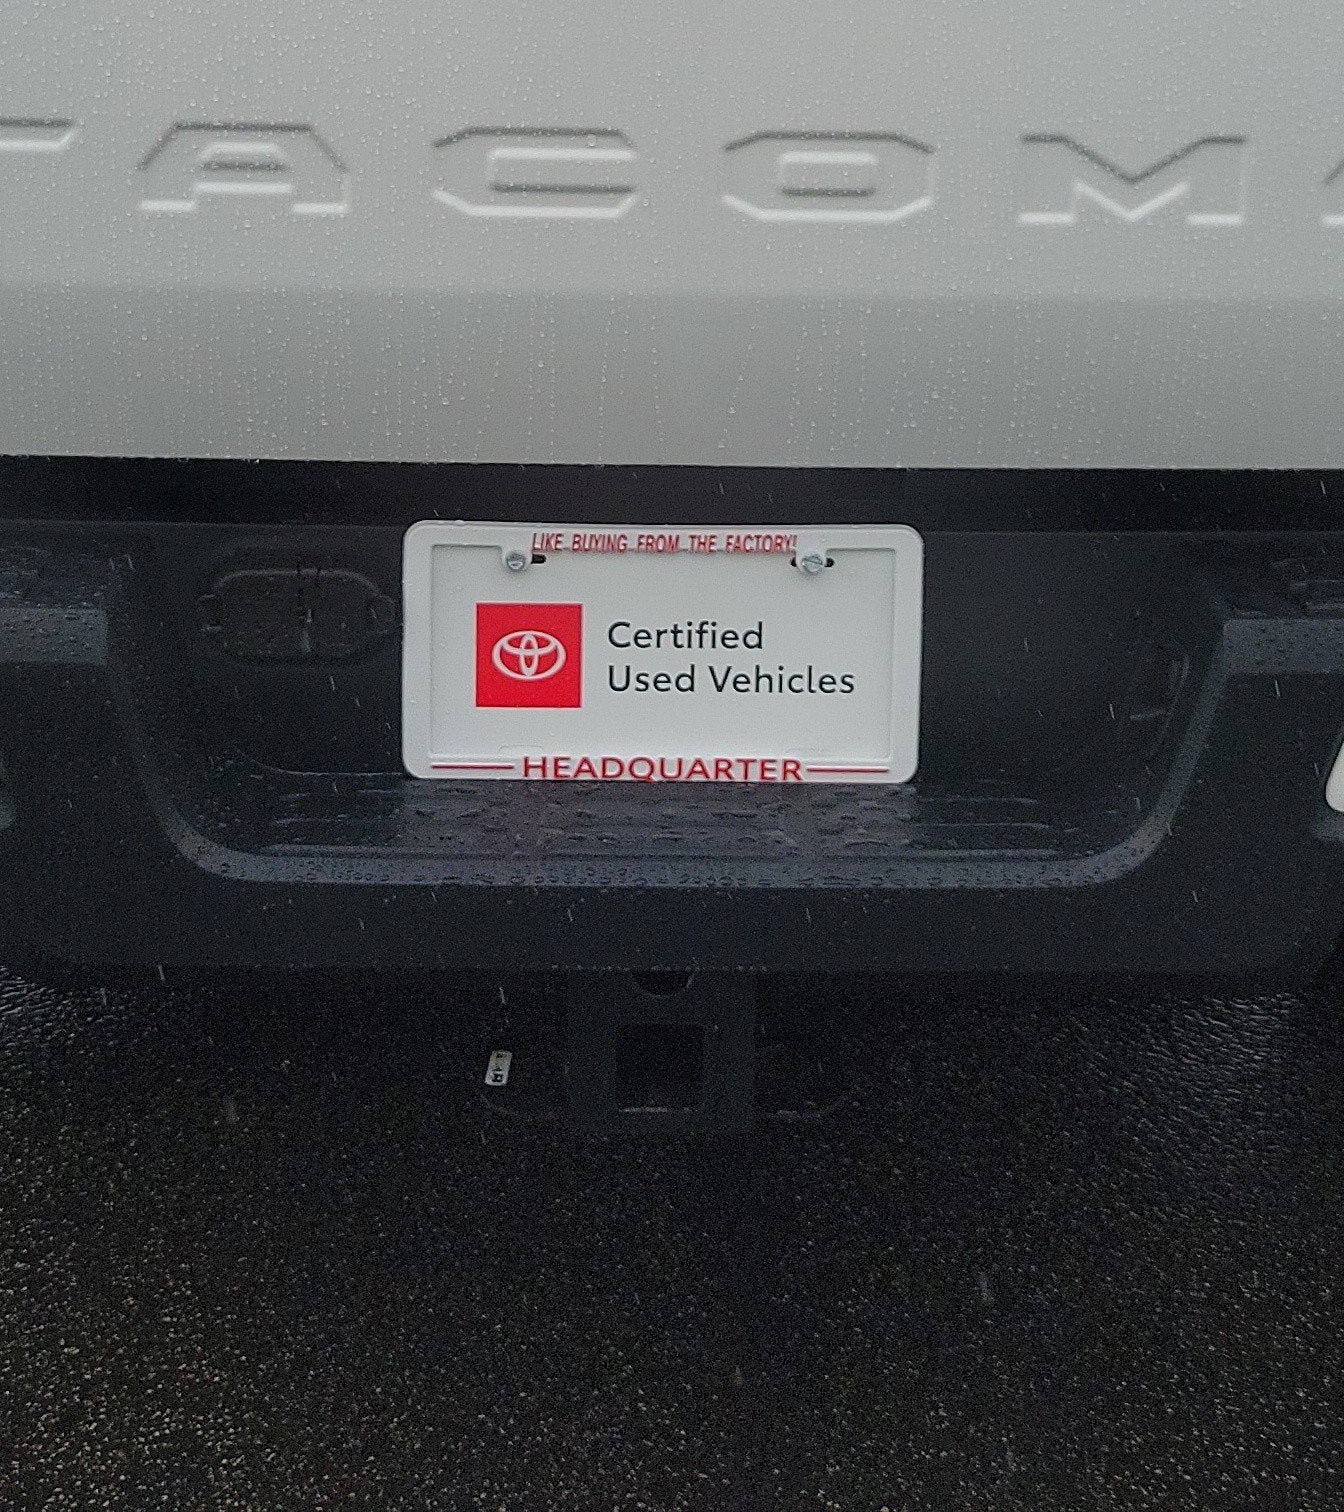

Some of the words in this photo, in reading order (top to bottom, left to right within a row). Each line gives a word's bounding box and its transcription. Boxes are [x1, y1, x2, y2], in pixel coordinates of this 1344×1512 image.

[532, 532, 565, 552] LIKE
[571, 533, 628, 553] BUYING
[637, 533, 680, 553] FROM
[688, 534, 717, 554] THE
[725, 534, 798, 554] FACTORY!
[607, 619, 765, 651] Certified
[607, 664, 696, 694] Used
[708, 664, 856, 695] Vehicles
[522, 755, 804, 784] HEADQUARTER
